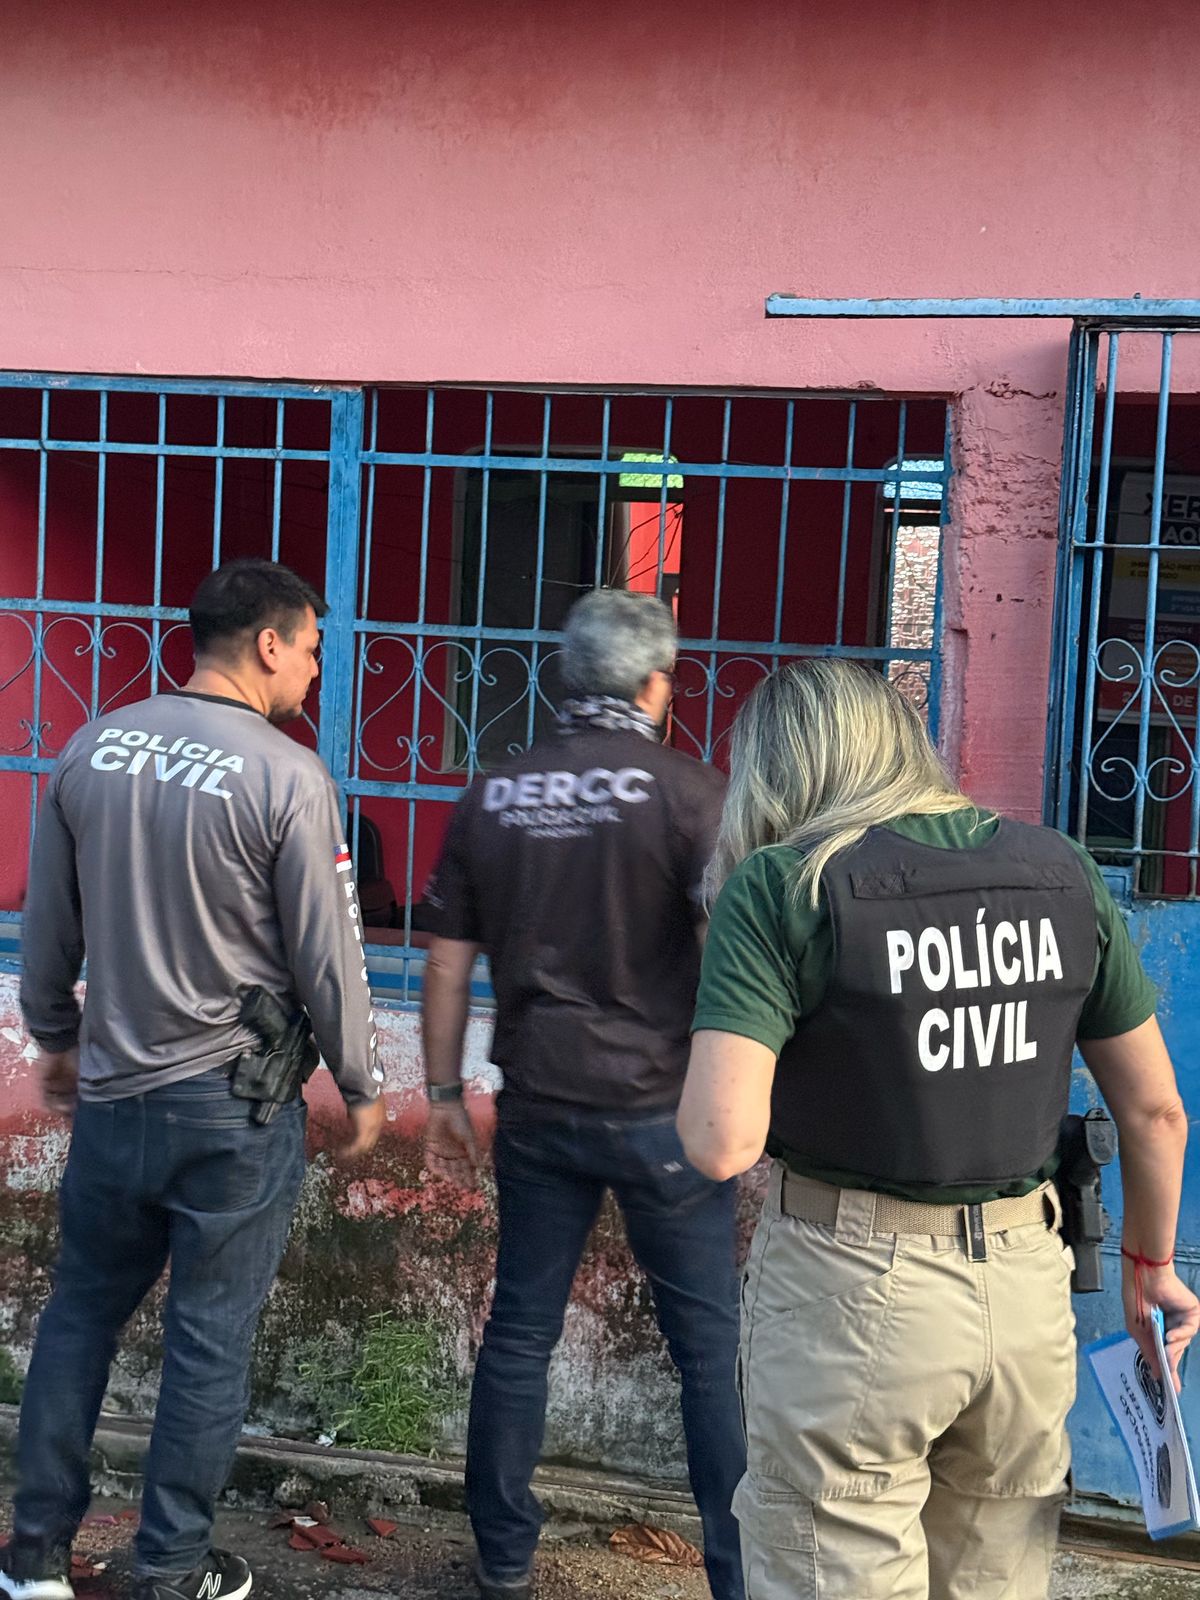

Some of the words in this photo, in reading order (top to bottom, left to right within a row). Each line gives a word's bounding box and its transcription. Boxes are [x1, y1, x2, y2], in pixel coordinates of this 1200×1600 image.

[90, 745, 233, 800] CIVIL
[96, 728, 244, 774] POLÍCIA
[482, 767, 656, 812] DERCC
[886, 907, 1064, 994] POLÍCIA
[917, 1000, 1038, 1072] CIVIL
[196, 1571, 222, 1599] N
